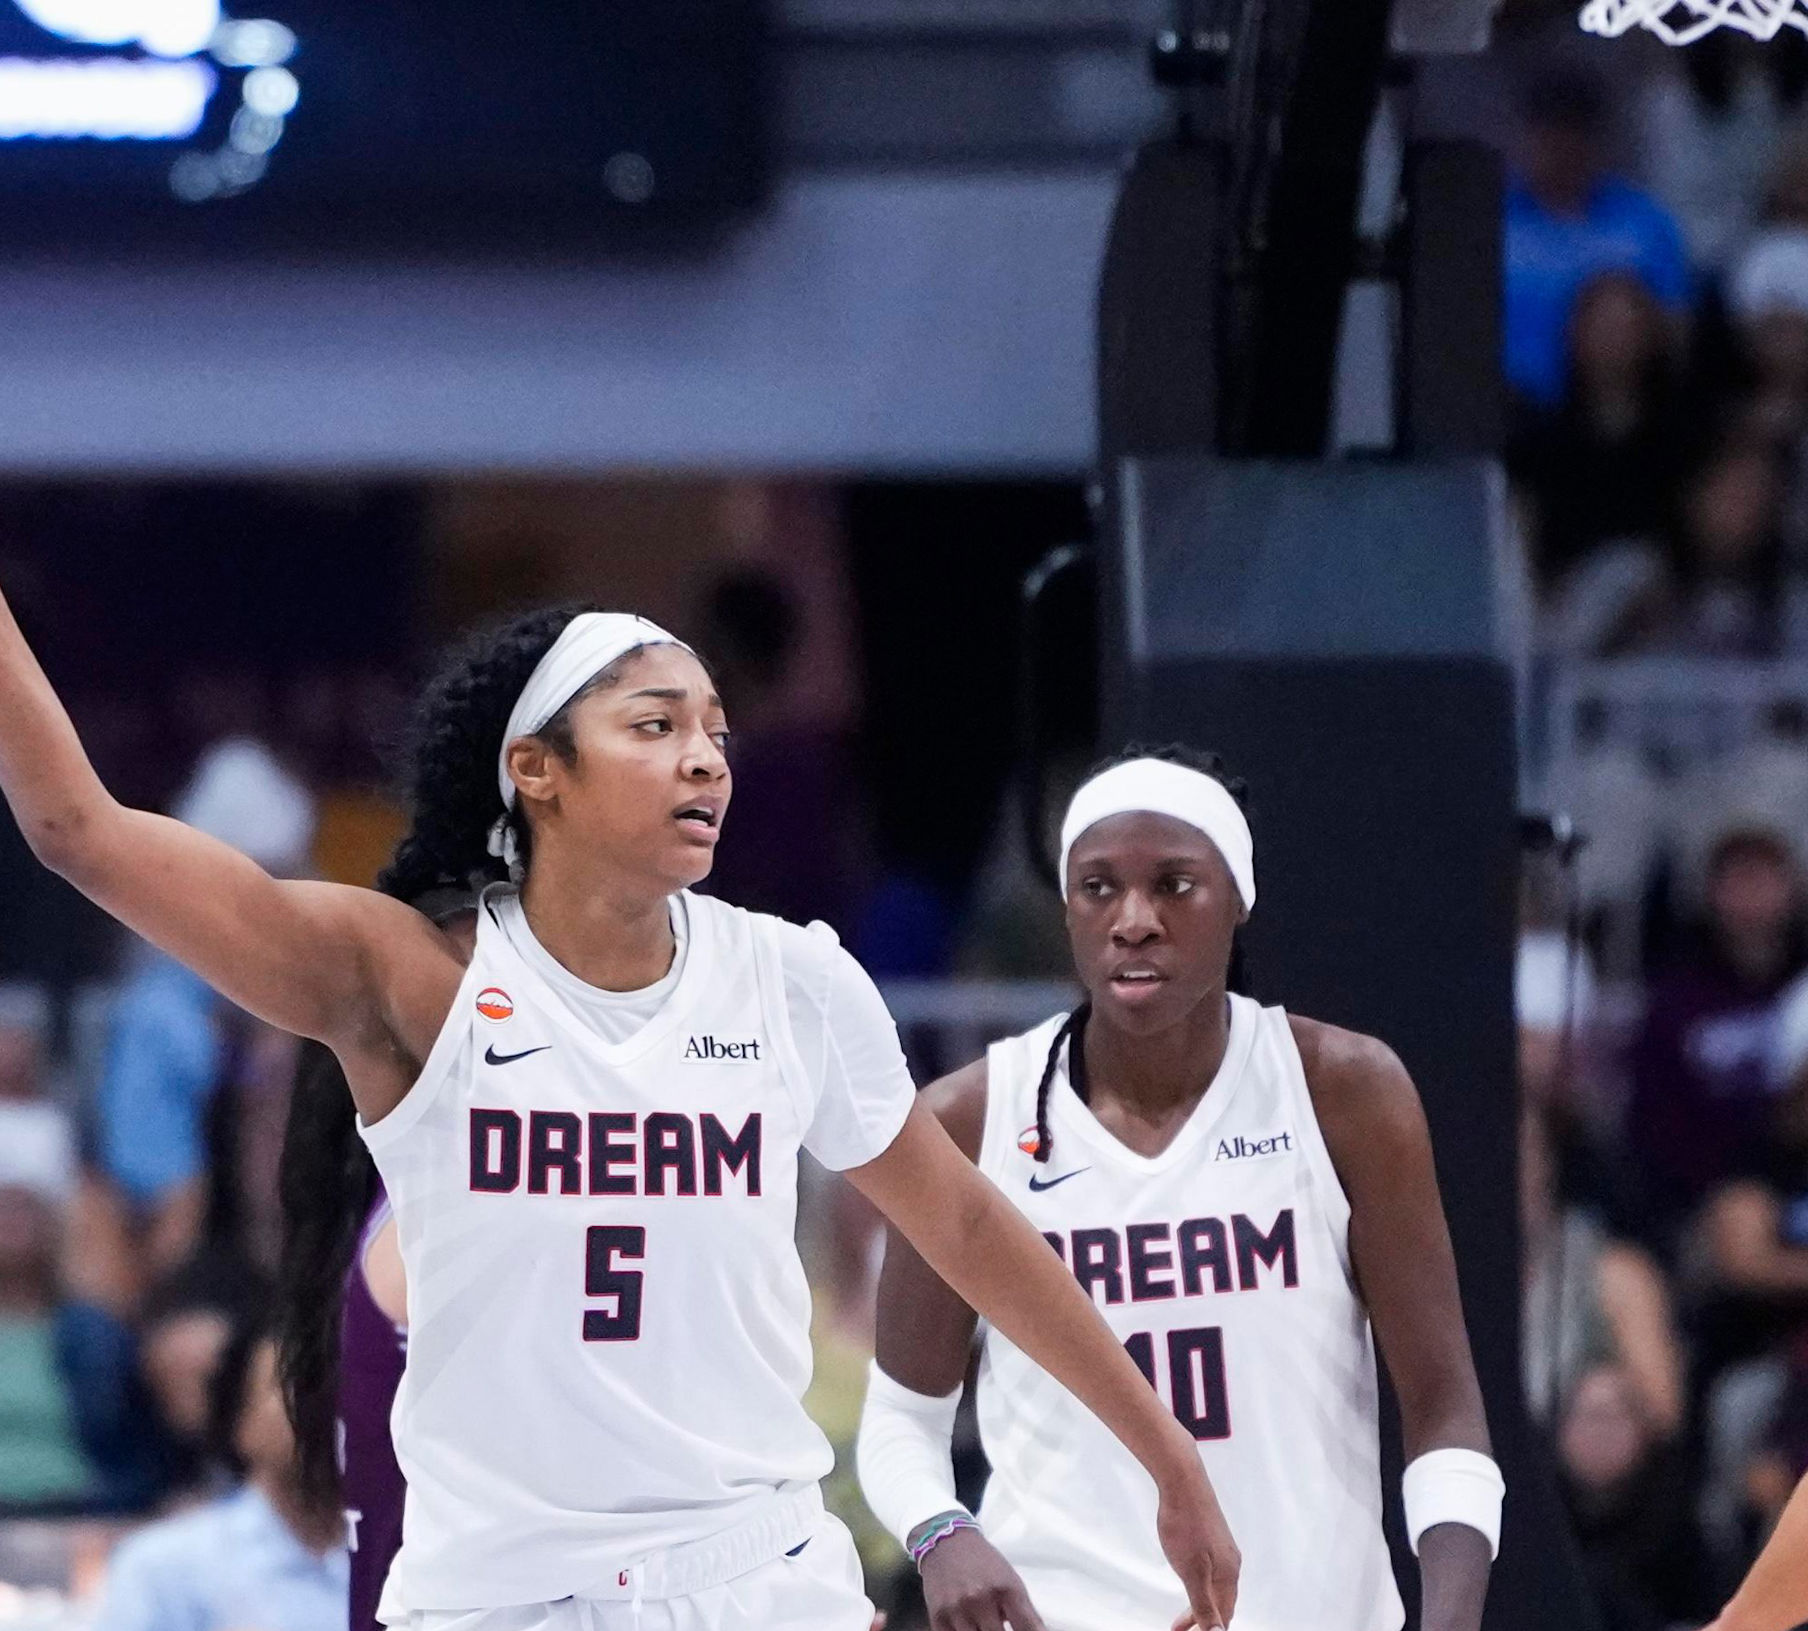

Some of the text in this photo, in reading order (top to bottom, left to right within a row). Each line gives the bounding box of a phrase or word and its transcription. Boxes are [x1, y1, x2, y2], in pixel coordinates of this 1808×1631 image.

[684, 1035, 760, 1060] Albert
[469, 1108, 762, 1197] DREAM
[1214, 1131, 1293, 1161] Albert
[582, 1225, 646, 1342] 5
[1041, 1208, 1300, 1305] REAM
